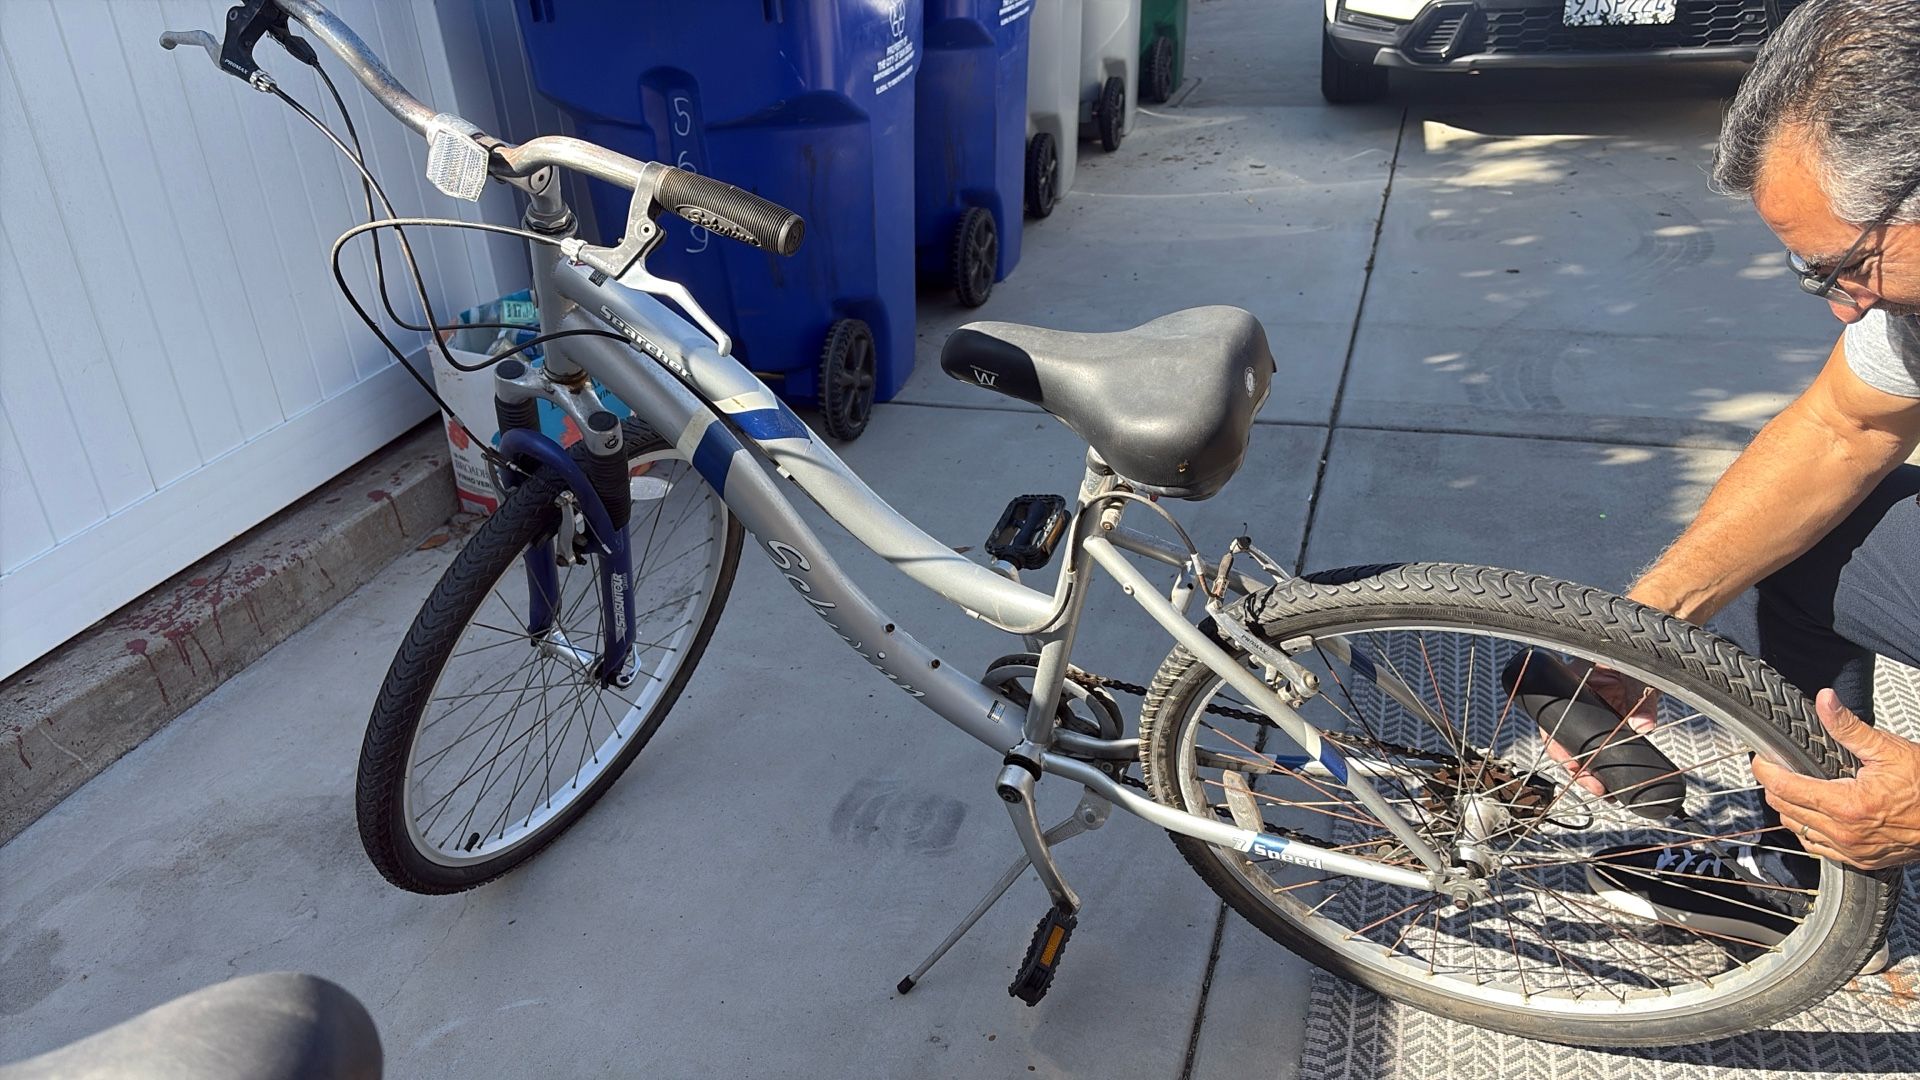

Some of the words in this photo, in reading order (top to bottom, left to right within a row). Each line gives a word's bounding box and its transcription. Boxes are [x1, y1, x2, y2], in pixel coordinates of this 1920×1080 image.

[224, 58, 249, 75] PROMAX
[600, 304, 692, 378] Searcher
[1253, 842, 1323, 870] Speed
